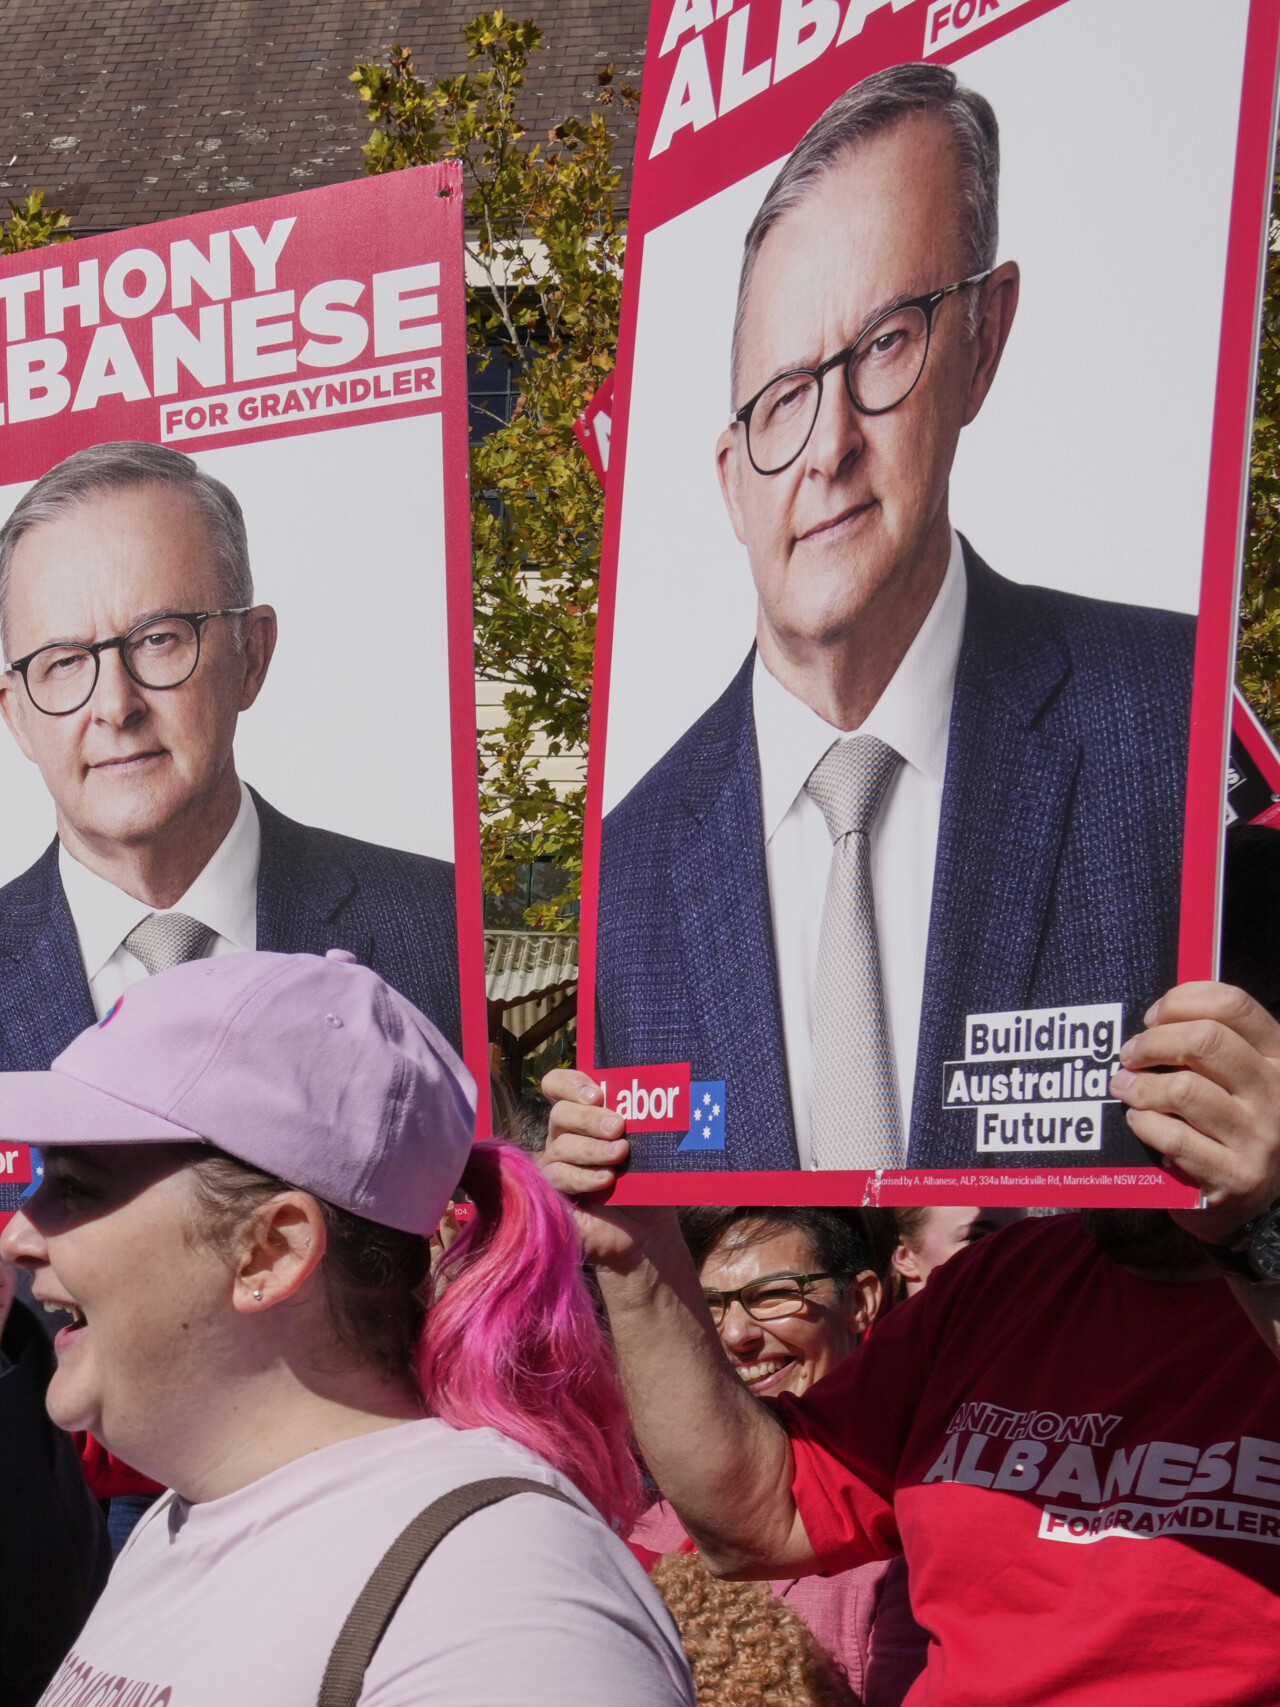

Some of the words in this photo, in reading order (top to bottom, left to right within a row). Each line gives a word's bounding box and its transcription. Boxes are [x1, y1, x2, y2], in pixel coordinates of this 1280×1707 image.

[166, 403, 228, 434] FOR
[238, 366, 436, 420] GRAYNDLER
[970, 1012, 1114, 1059] Building
[983, 1112, 1094, 1145] Future
[904, 1176, 912, 1187] by
[914, 1176, 921, 1185] A.
[923, 1176, 959, 1187] Albanese,
[960, 1176, 978, 1186] ALP,
[979, 1176, 999, 1185] 334a
[1001, 1175, 1046, 1185] Marrickville
[1048, 1175, 1062, 1186] Rd,
[1064, 1175, 1113, 1185] Marrickville
[1114, 1175, 1137, 1184] NSW
[1138, 1175, 1165, 1185] 2204.
[946, 1402, 1123, 1446] ANTHONY
[922, 1433, 1280, 1503] ALBANESE
[1047, 1512, 1100, 1537] FOR
[1104, 1506, 1280, 1537] GRAYNDLER
